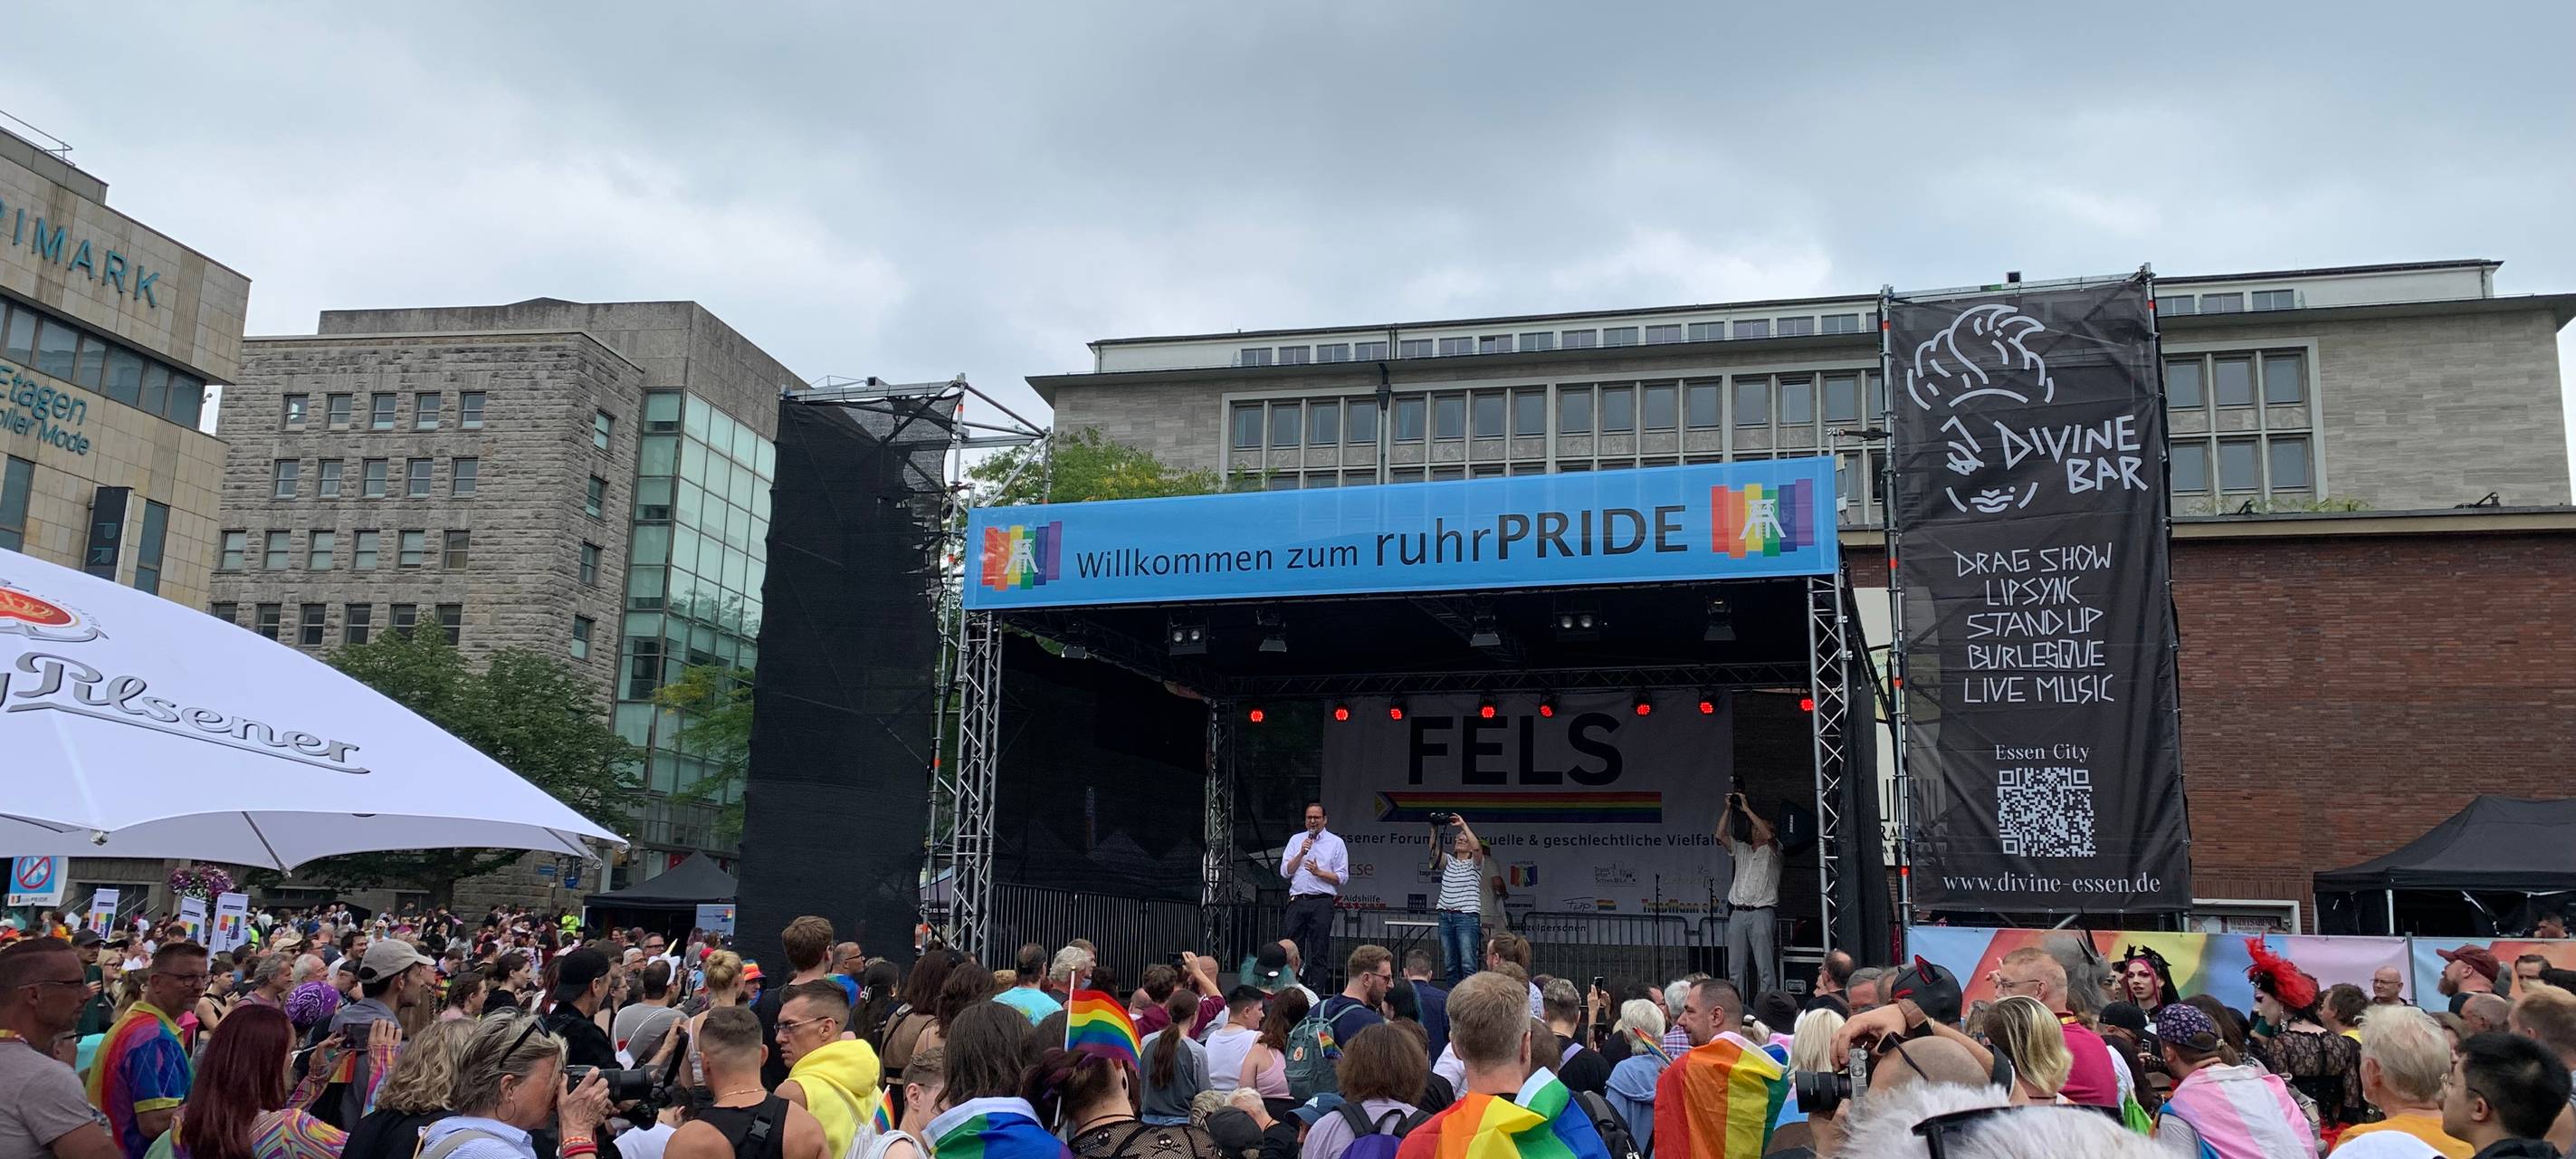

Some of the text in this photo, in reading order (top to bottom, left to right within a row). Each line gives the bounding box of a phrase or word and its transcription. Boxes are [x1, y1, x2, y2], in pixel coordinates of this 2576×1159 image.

[0, 199, 160, 309] IMARK
[37, 419, 90, 455] Mode
[1994, 415, 2142, 471] DIVINE
[2066, 455, 2149, 494] BAR
[1075, 504, 1689, 580] Willkommen zum ruhrPRIDE
[1953, 542, 2113, 578] DRAG SHOW
[1986, 575, 2080, 607] LIPSYNC
[1966, 607, 2104, 639] STAND UP
[1968, 638, 2106, 670] BURLESQUE
[1963, 673, 2115, 704] LIVE MUSIC
[14, 651, 361, 763] Pilsener
[1408, 712, 1624, 786] FELS
[1995, 743, 2090, 763] Essen City
[1340, 832, 1385, 844] ssener
[1529, 834, 1539, 846] &
[1543, 833, 1662, 848] geschlechtliche
[1343, 894, 1380, 903] Aidshilfe
[1942, 871, 2161, 894] www.divine-essen.de
